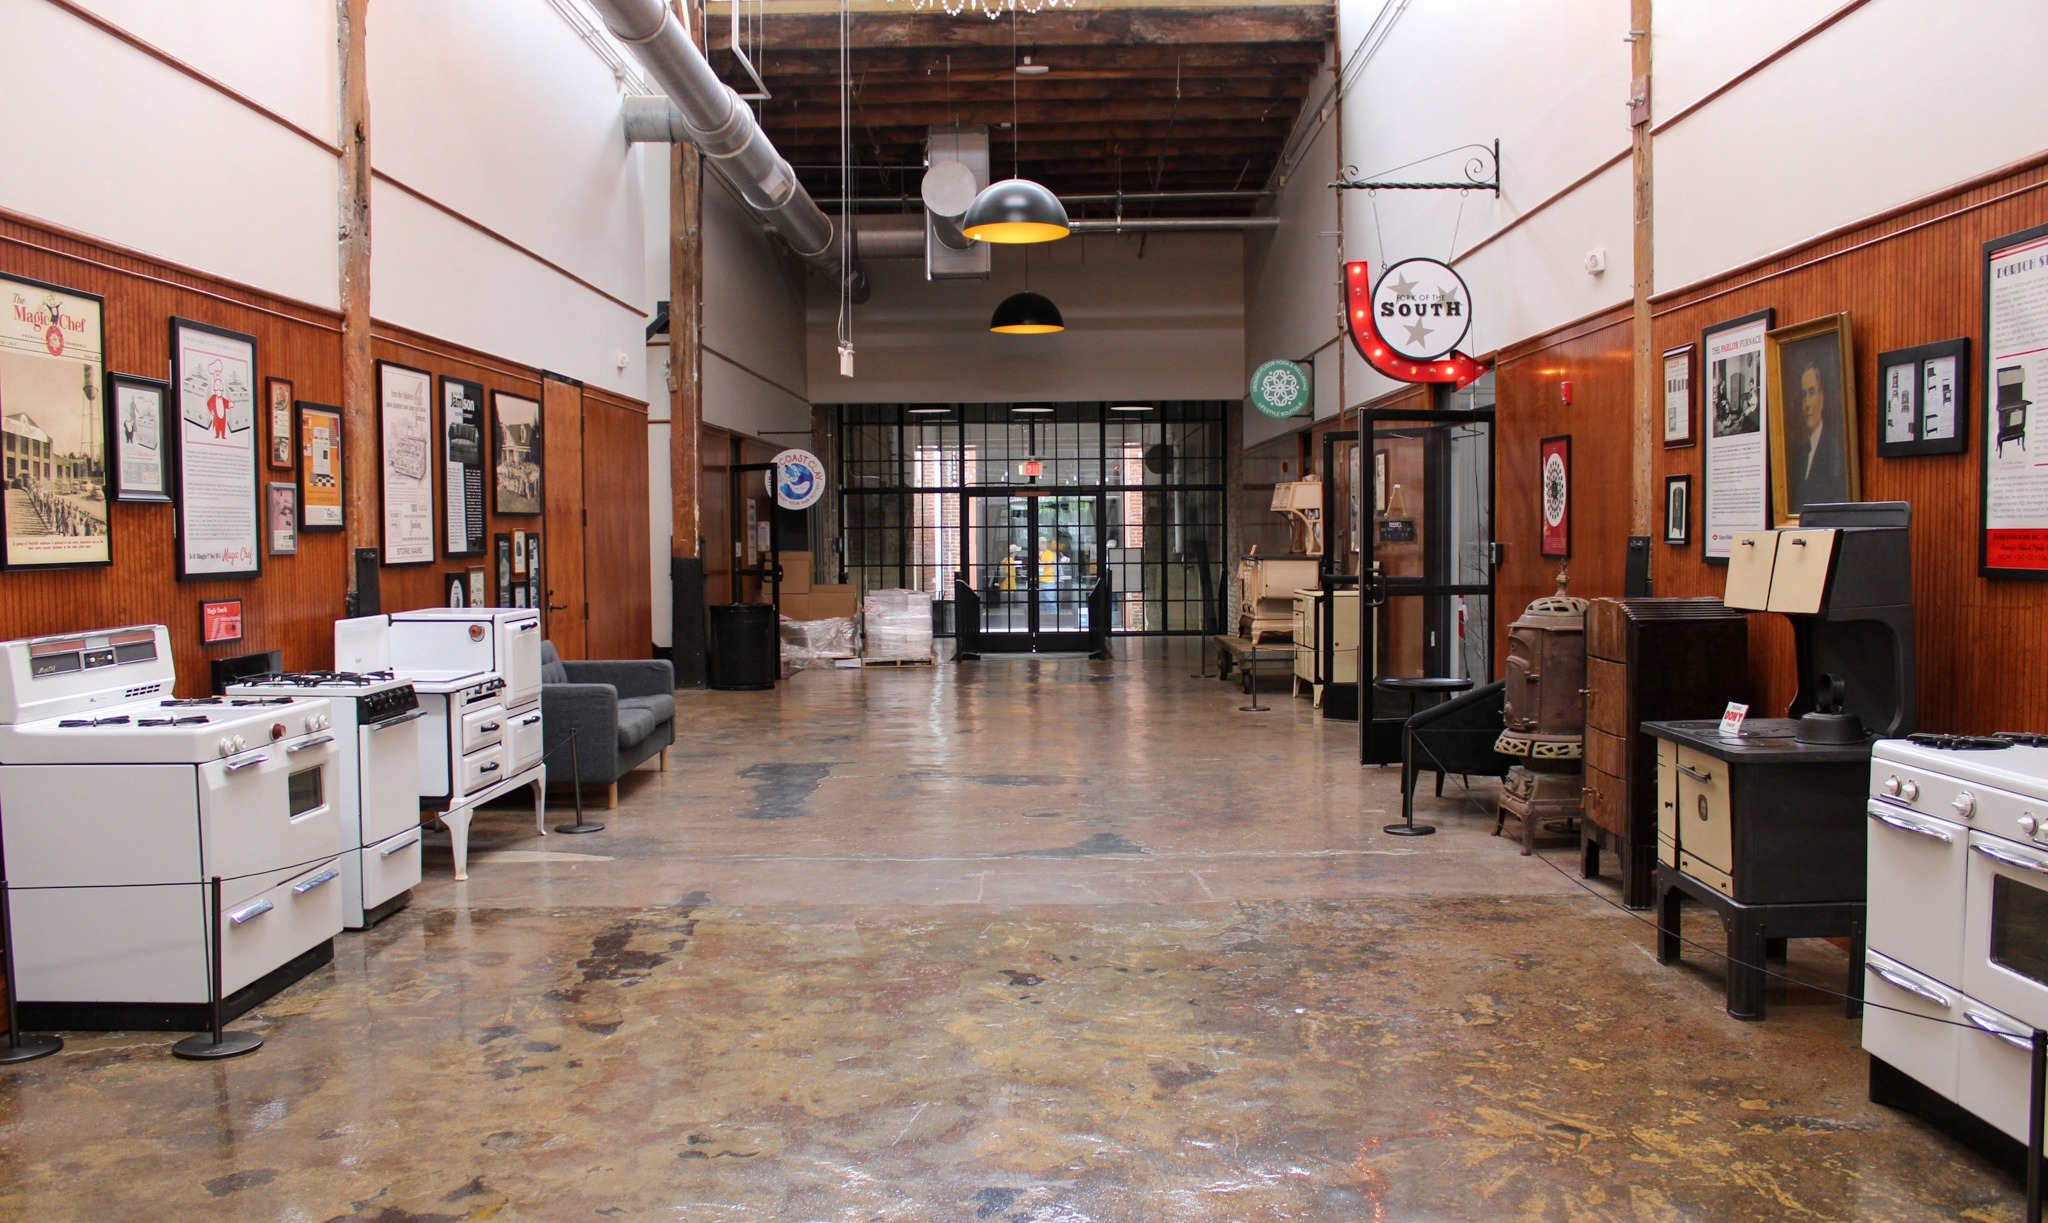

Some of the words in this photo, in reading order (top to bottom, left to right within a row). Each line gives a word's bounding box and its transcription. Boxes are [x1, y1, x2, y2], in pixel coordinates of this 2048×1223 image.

[1996, 258, 2036, 279] DORTCH
[13, 292, 25, 304] The
[1396, 294, 1416, 302] FORK
[1418, 294, 1430, 302] OF
[1432, 294, 1446, 302] THE
[1380, 301, 1461, 317] SOUTH
[13, 304, 49, 333] Magic
[59, 313, 87, 333] Chef
[1711, 345, 1720, 355] THE
[1720, 341, 1739, 353] PARLOR
[1739, 335, 1762, 348] FURNACE
[1258, 402, 1280, 417] LIFESTYLE
[1280, 401, 1303, 417] BOUTIQUE
[778, 454, 809, 466] COAST
[808, 460, 823, 481] CLAY
[222, 547, 240, 566] Magic
[240, 546, 254, 565] Chef
[1723, 710, 1744, 723] DON'T
